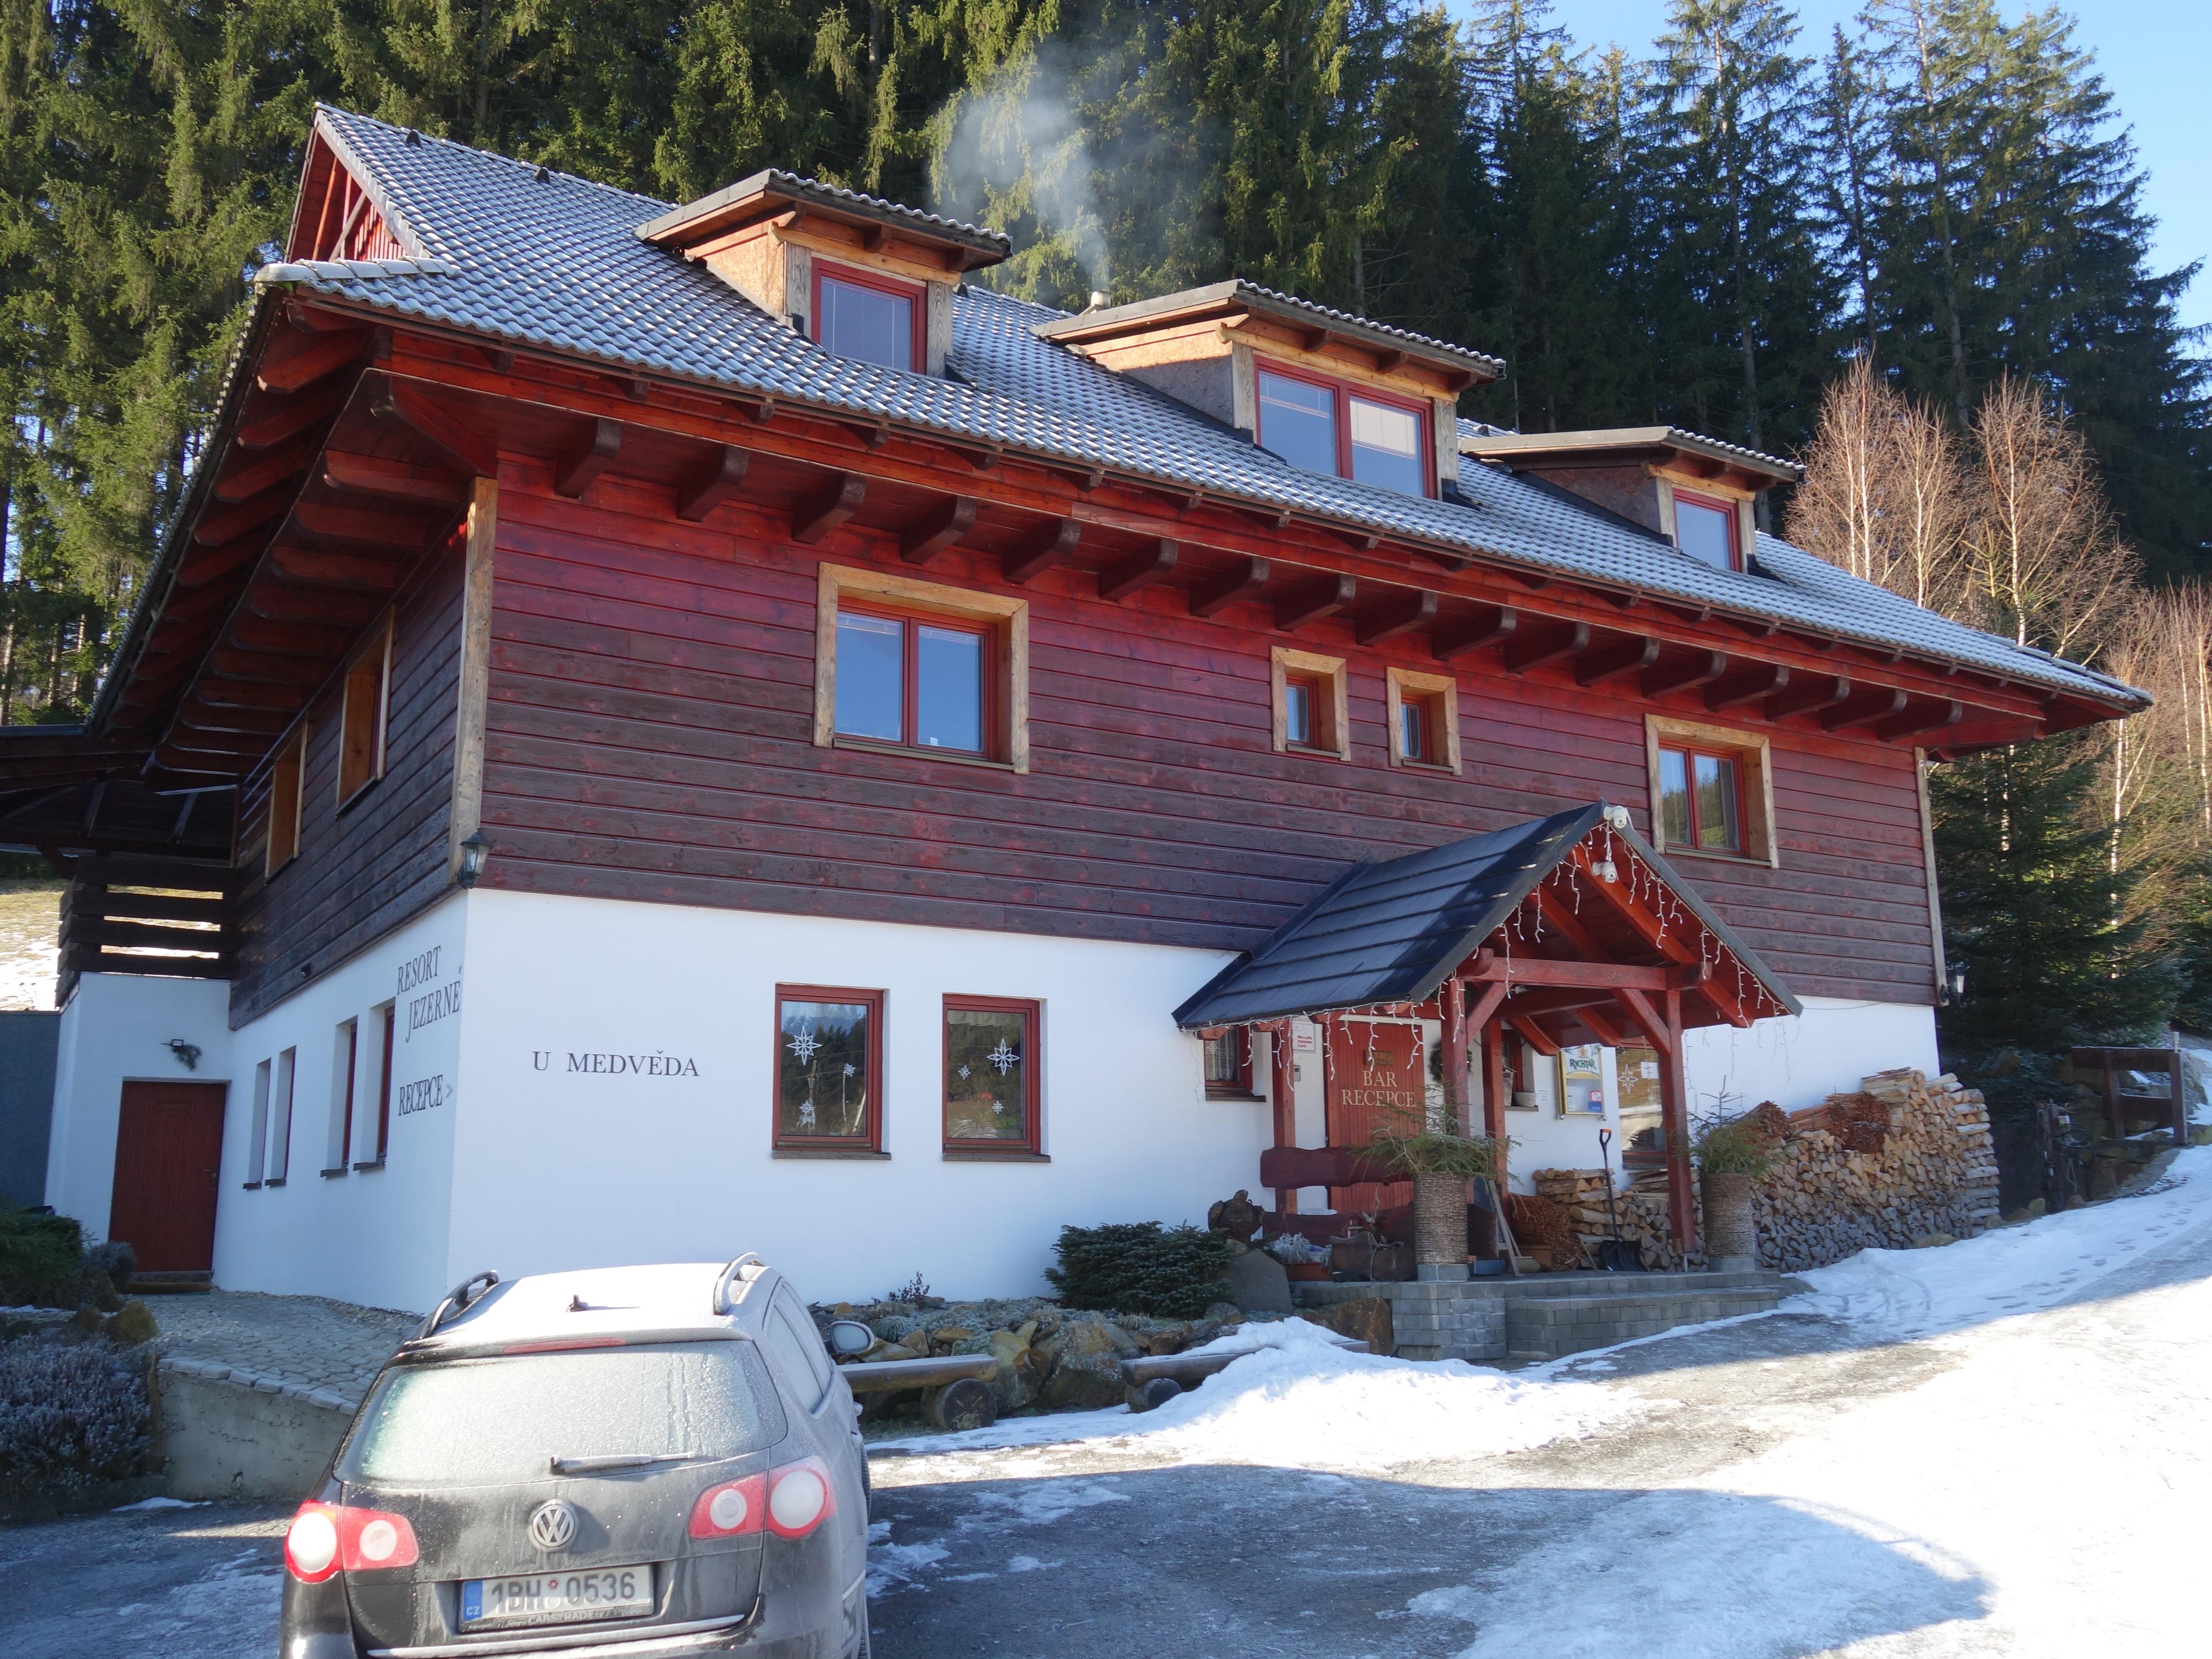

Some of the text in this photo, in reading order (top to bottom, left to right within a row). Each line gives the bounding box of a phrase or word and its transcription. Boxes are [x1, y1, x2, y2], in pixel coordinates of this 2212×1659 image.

[397, 945, 441, 995] RESORT
[405, 966, 462, 1043] JEZERNÉ
[531, 1050, 700, 1077] U MEDVĚDA
[1363, 1071, 1397, 1087] BAR
[398, 1074, 443, 1116] RECEPCE
[1341, 1089, 1416, 1107] RECEPCE
[491, 1572, 635, 1614] 1BH 0536
[466, 1605, 481, 1616] CZ
